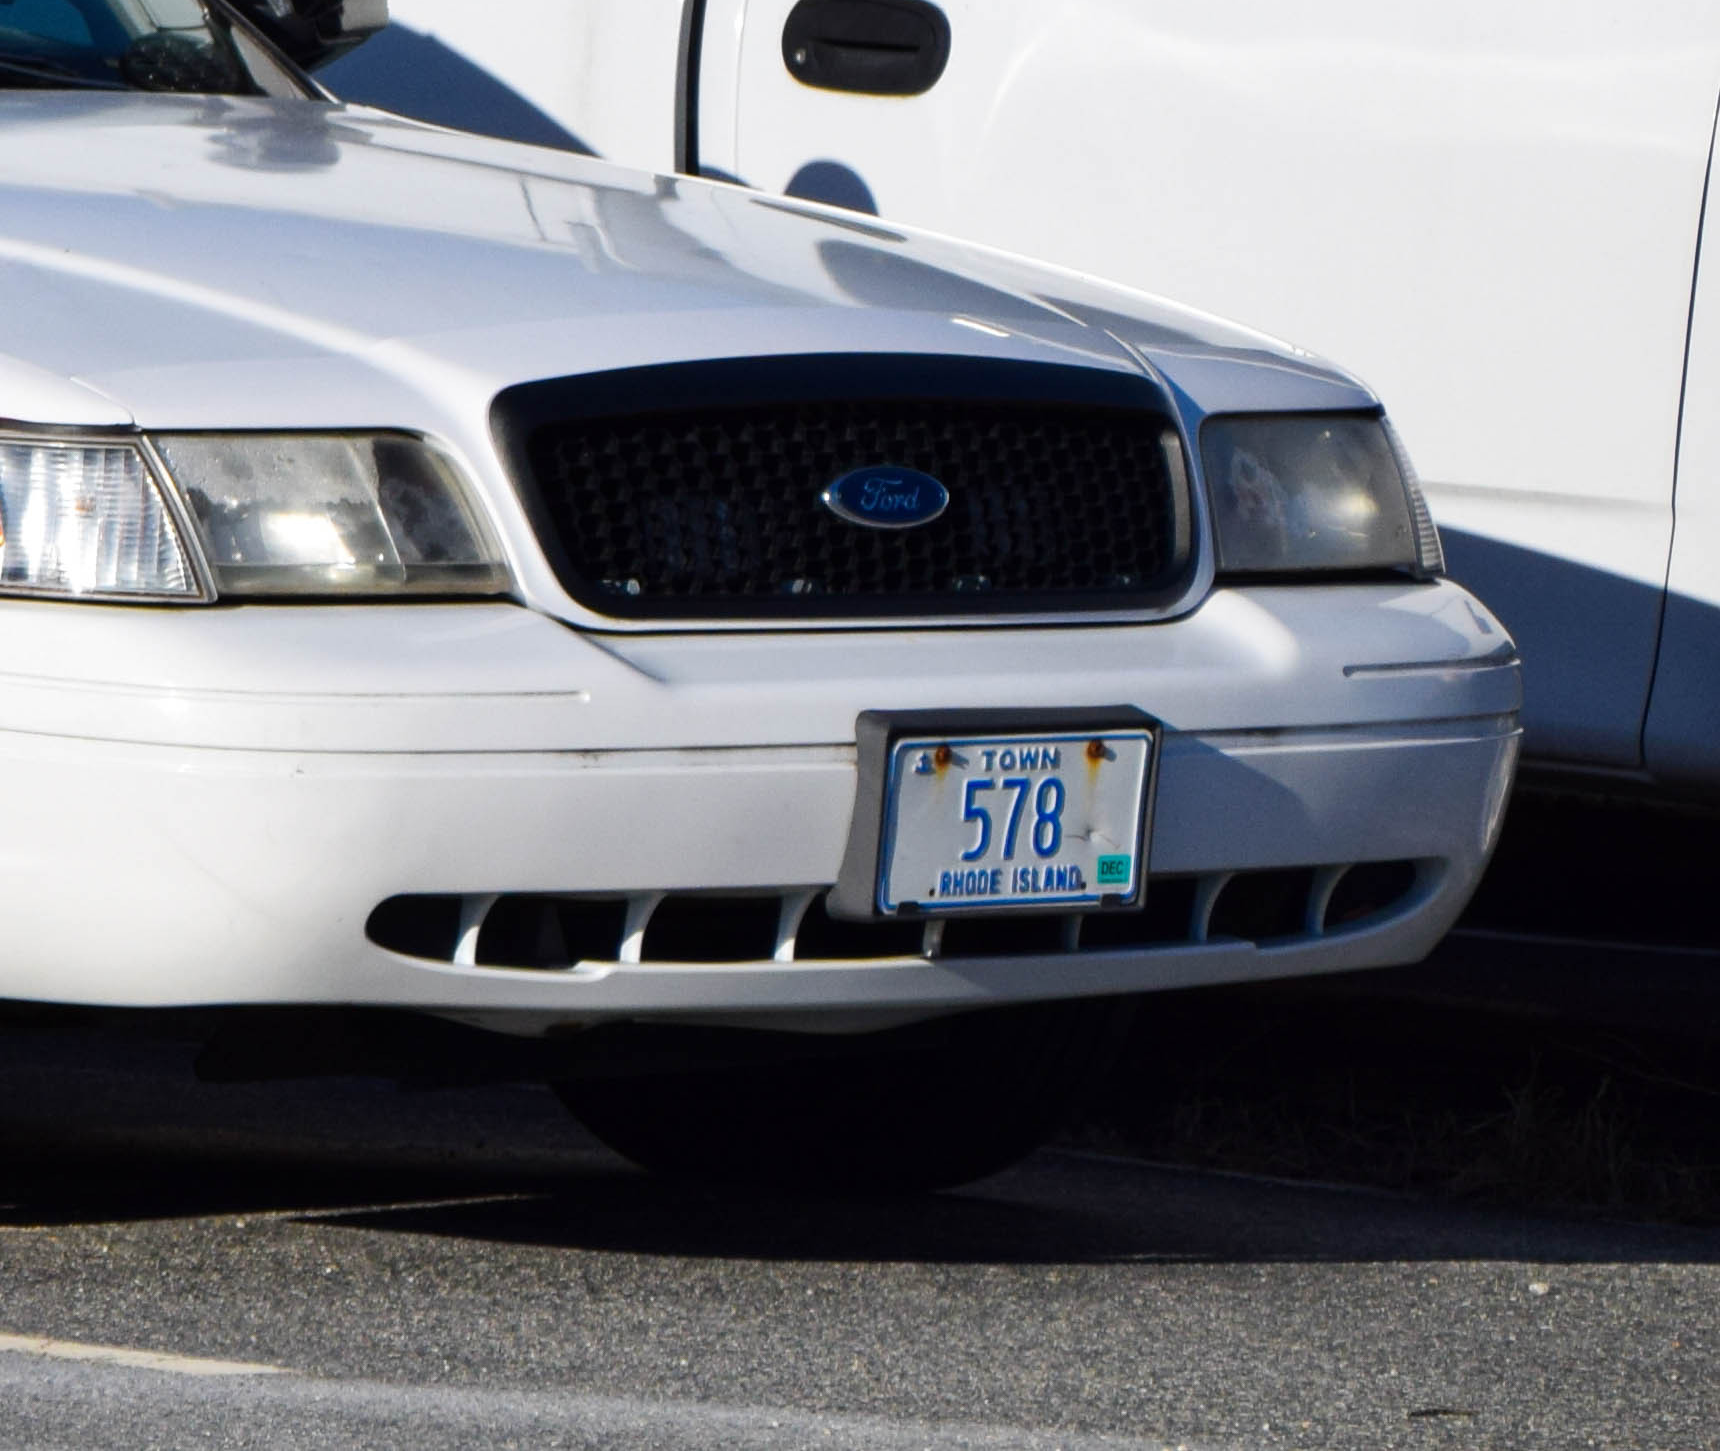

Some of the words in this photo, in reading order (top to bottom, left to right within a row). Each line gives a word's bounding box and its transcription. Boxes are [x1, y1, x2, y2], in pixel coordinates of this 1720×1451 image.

[860, 477, 921, 511] Ford
[980, 748, 1062, 773] TOWN
[960, 777, 1066, 863] 578
[938, 868, 1003, 898] RHODE
[1011, 865, 1085, 894] ISLAND
[1101, 861, 1124, 875] DEC
